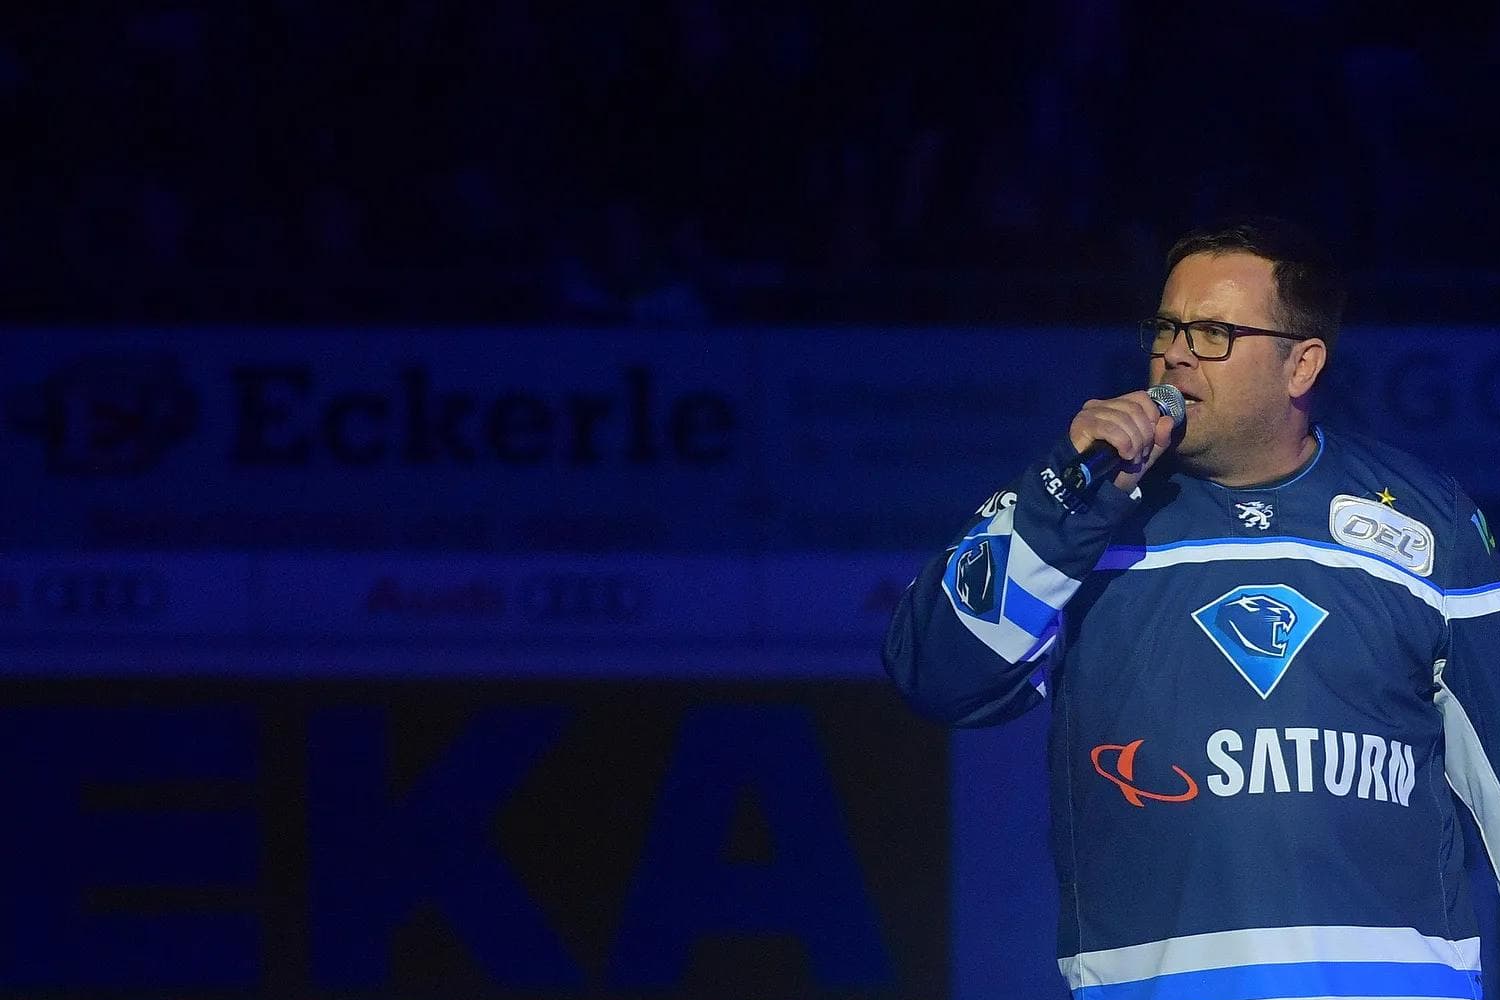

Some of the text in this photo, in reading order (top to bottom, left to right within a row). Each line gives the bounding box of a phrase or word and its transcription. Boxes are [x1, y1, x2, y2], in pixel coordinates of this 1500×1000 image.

[225, 358, 741, 469] Eckerle
[1206, 727, 1417, 807] SATURN
[0, 705, 897, 989] EKA
